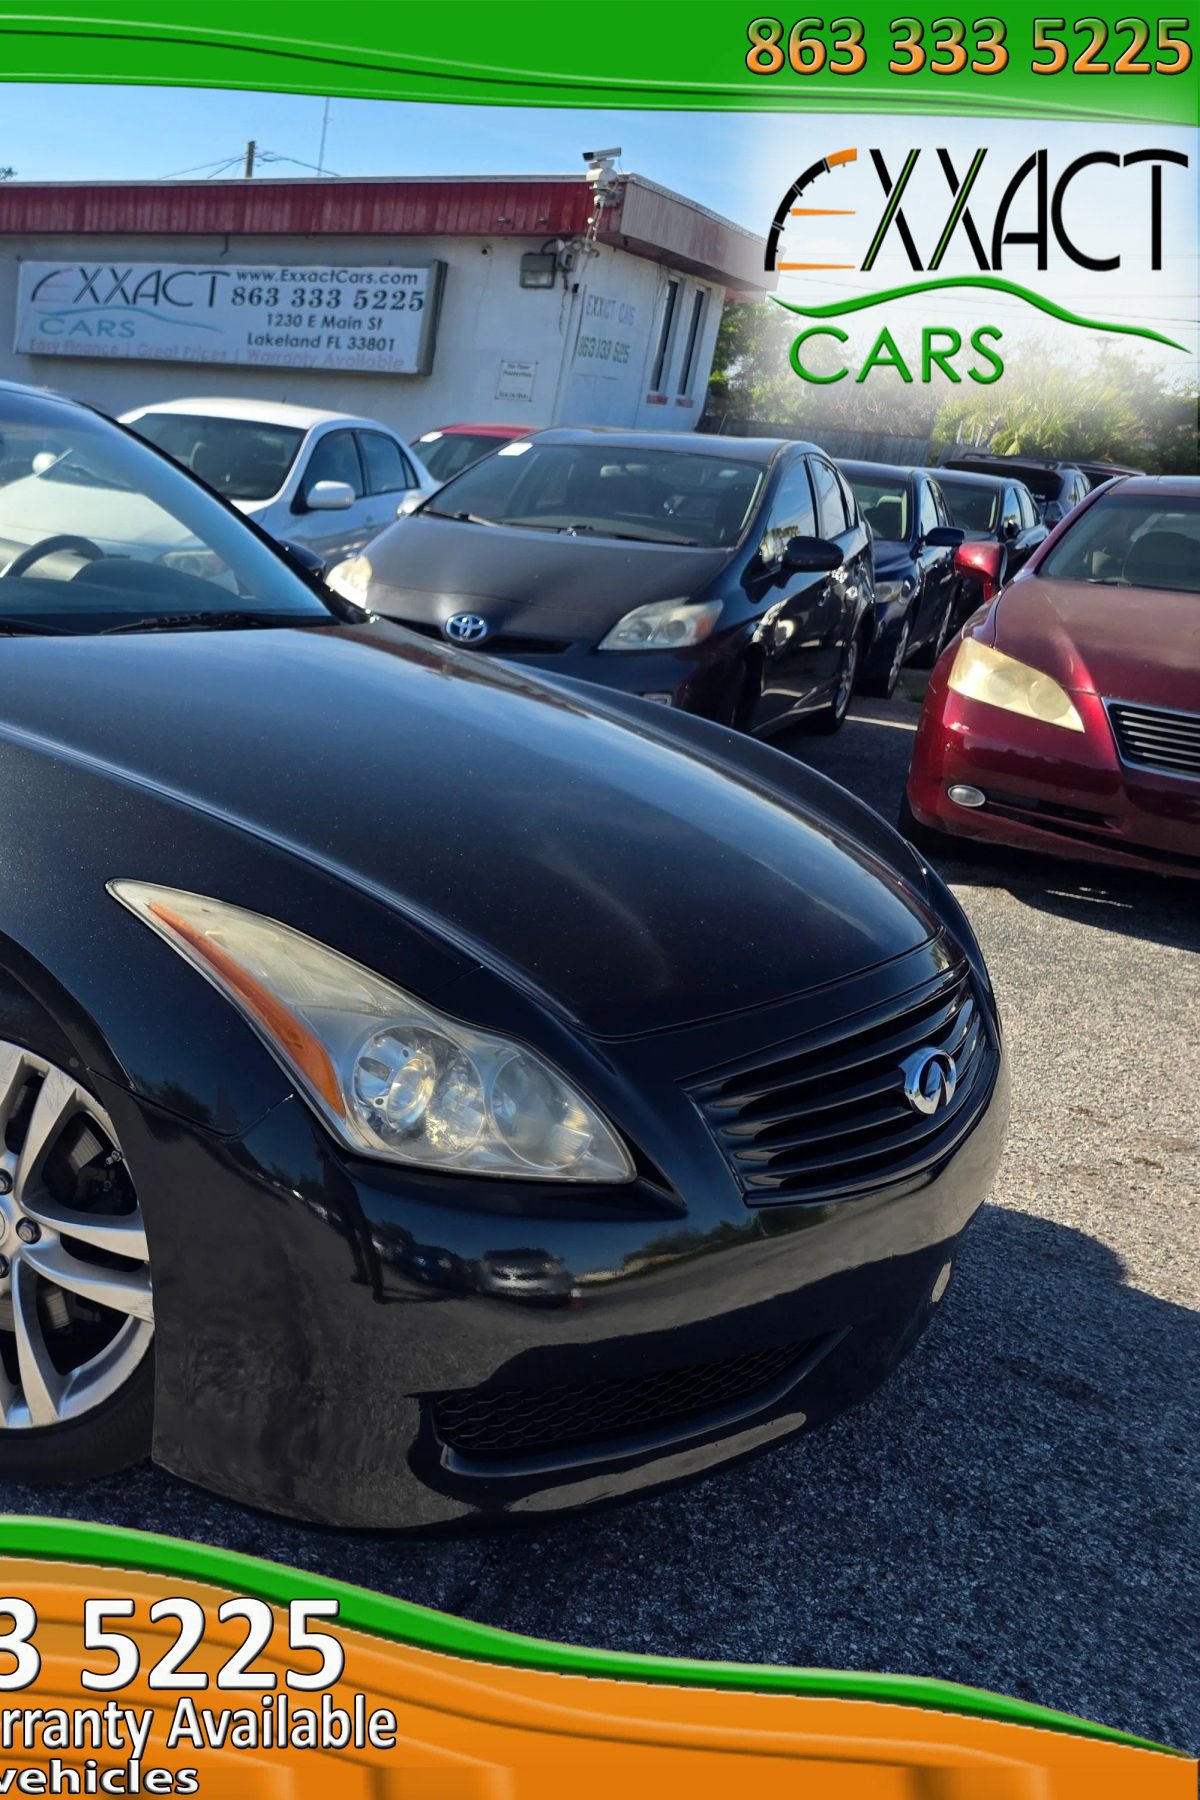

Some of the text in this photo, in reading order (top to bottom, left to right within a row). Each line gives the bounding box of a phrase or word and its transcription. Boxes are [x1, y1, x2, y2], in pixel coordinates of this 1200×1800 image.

[236, 269, 418, 285] www.ExxactCars.com
[31, 267, 231, 308] EXXACT
[231, 286, 425, 311] 863 333 5225
[39, 319, 136, 339] CARS
[267, 313, 383, 331] 1230 E Main St
[247, 332, 395, 352] Lakeland FL 33801
